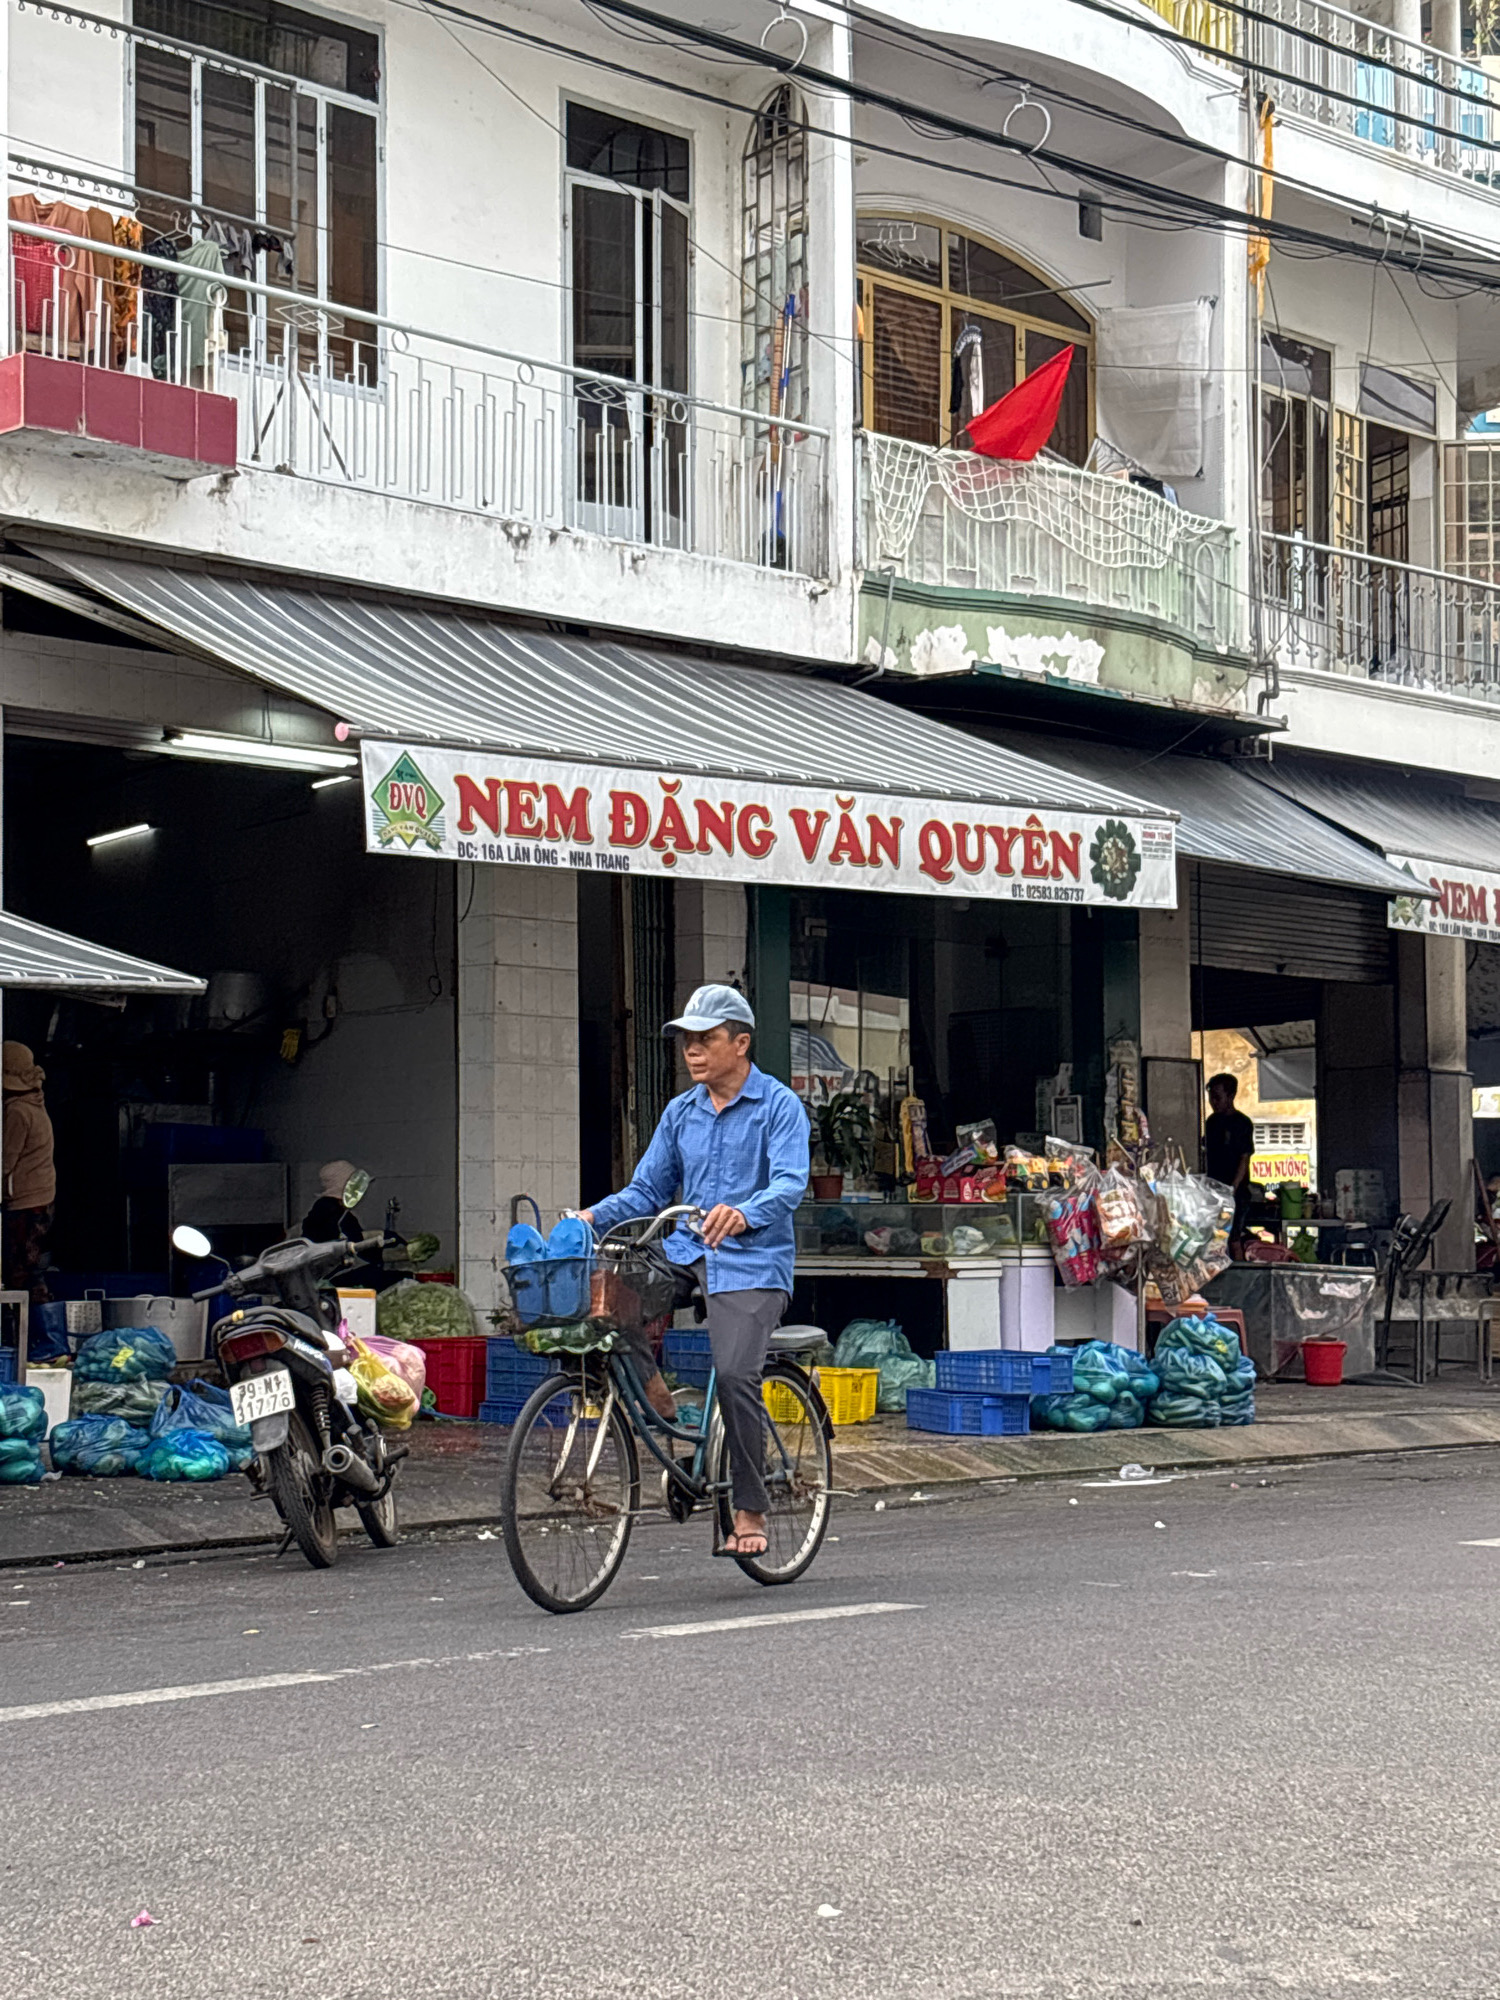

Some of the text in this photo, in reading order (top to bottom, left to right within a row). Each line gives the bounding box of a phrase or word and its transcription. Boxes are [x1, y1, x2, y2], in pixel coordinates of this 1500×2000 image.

[388, 782, 427, 820] ĐVQ
[454, 774, 1082, 884] NEM ĐẶNG VĂN QUYÊN
[457, 841, 478, 859] ĐC:
[481, 843, 504, 861] 16A
[534, 844, 558, 865] ÔNG
[569, 850, 592, 868] NHA
[595, 853, 630, 871] TRANG
[1429, 877, 1488, 925] NEM
[1252, 1161, 1272, 1178] NEM
